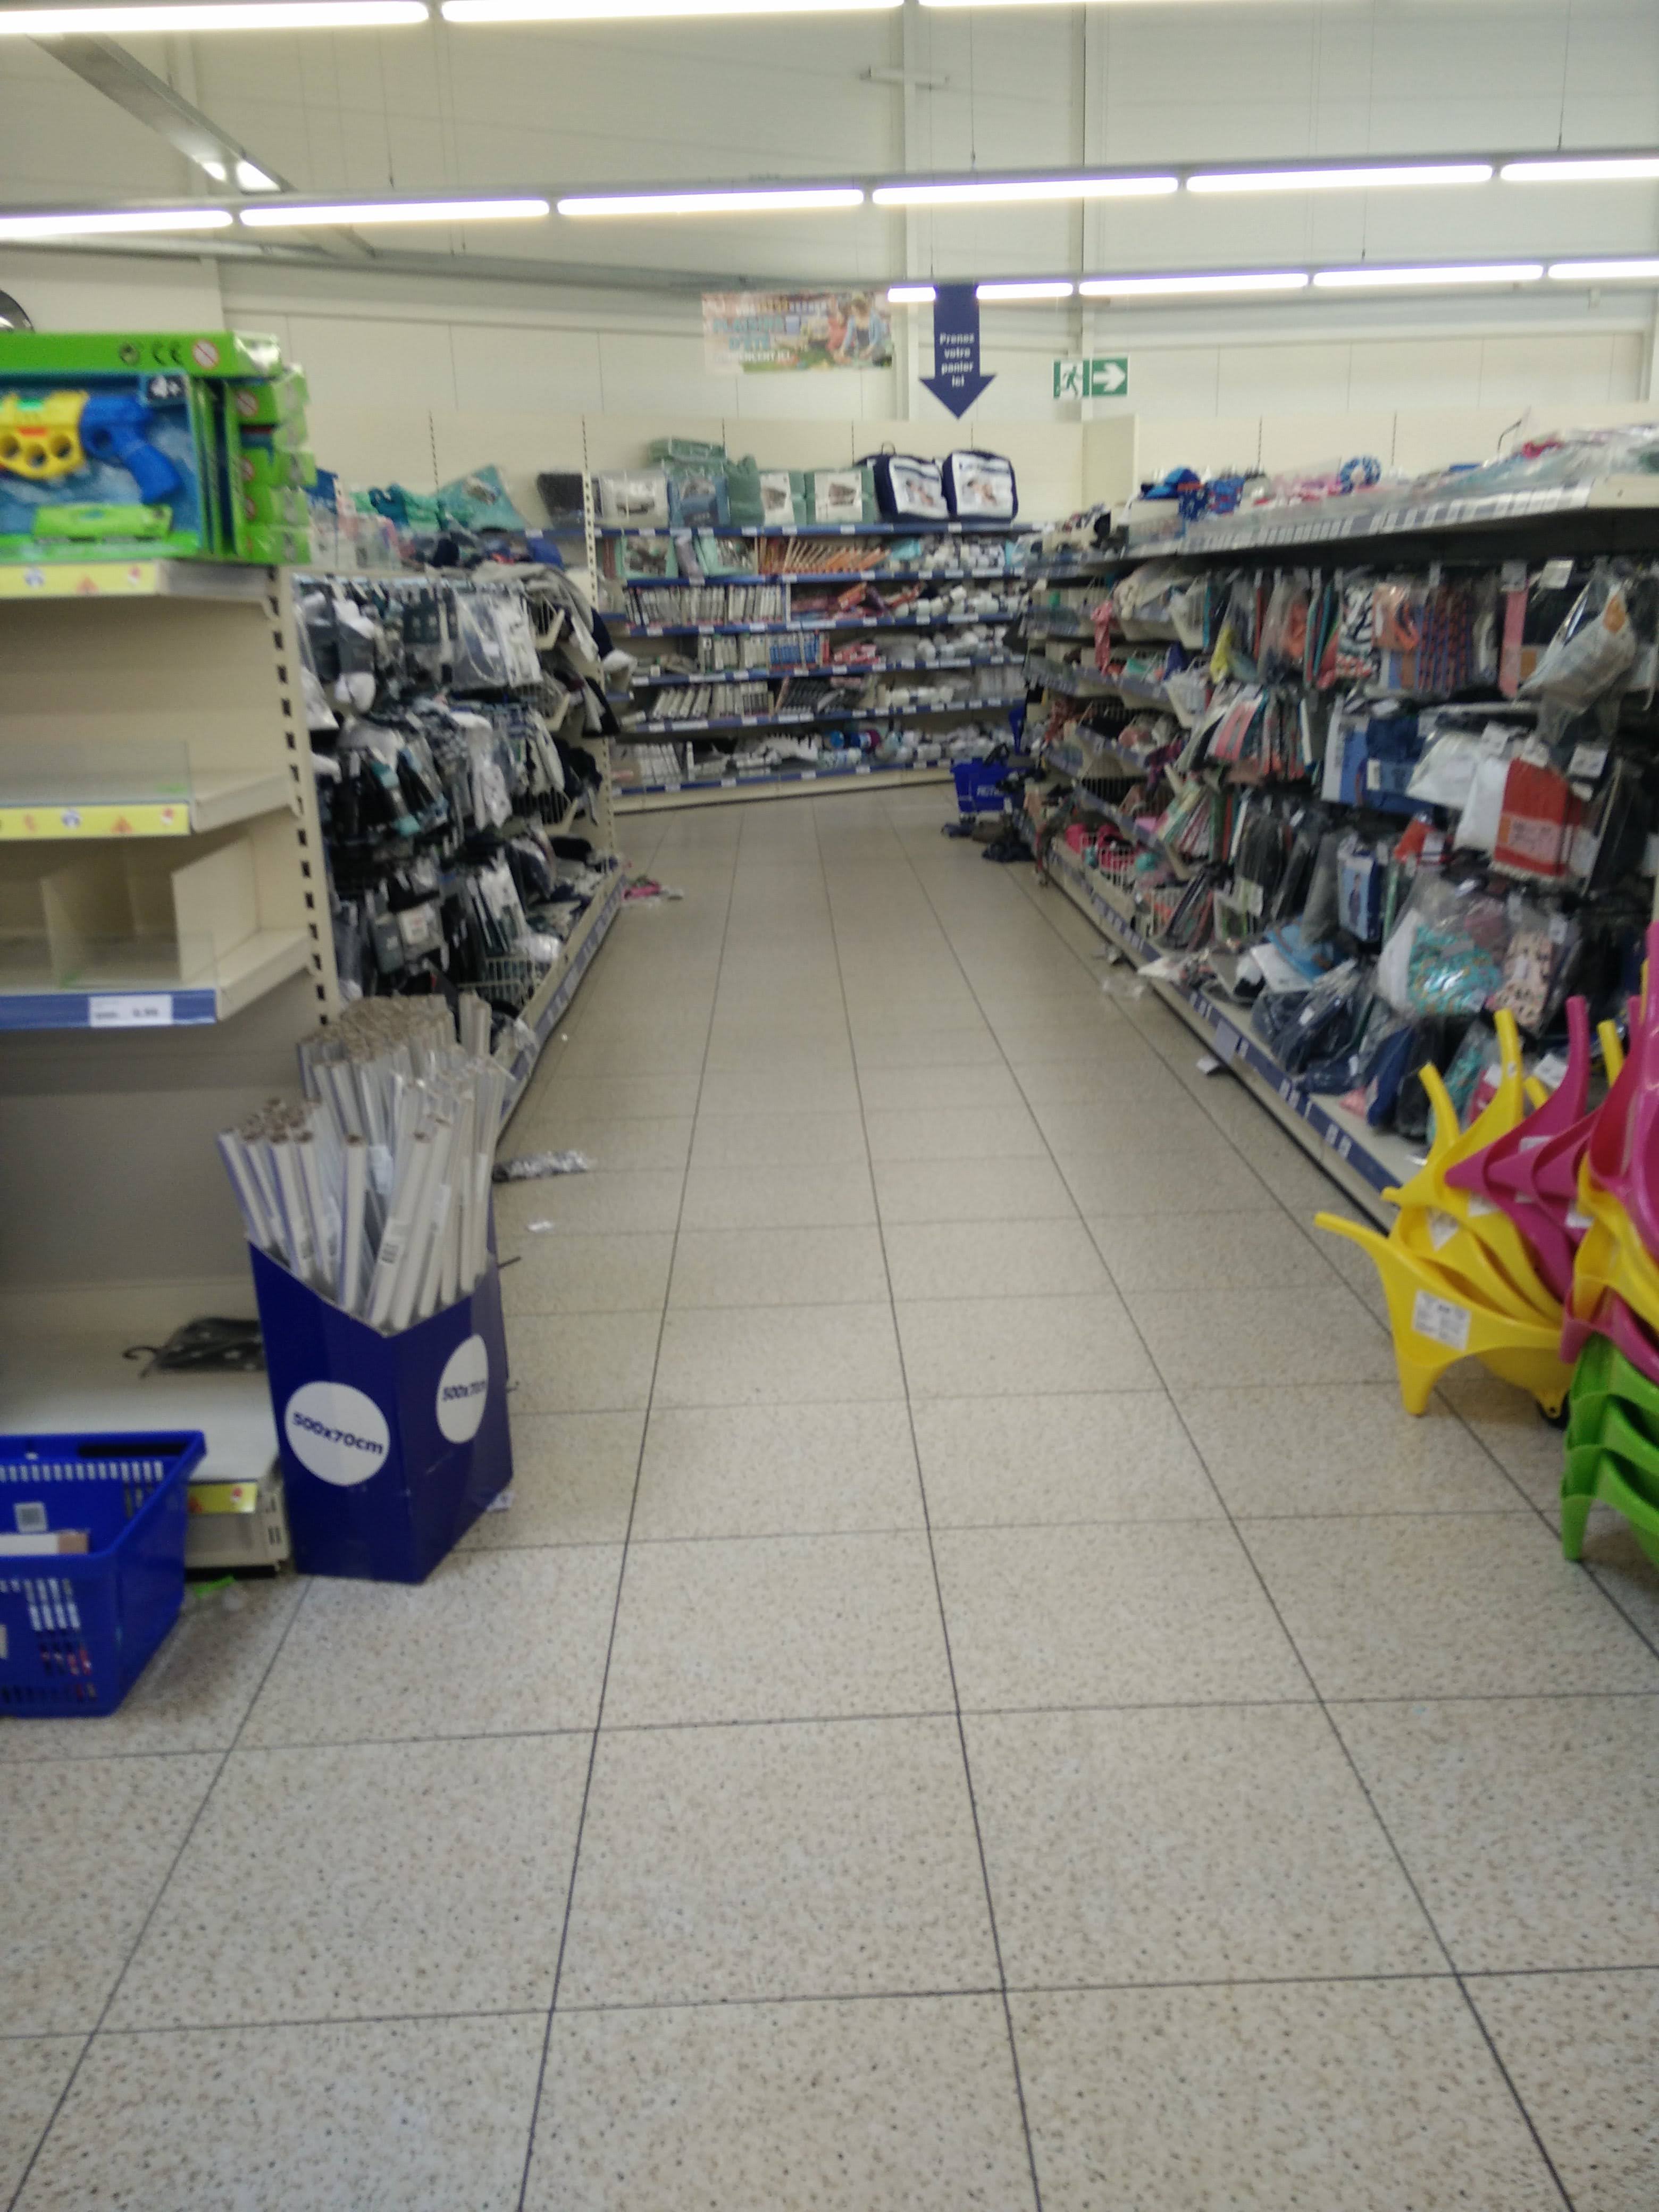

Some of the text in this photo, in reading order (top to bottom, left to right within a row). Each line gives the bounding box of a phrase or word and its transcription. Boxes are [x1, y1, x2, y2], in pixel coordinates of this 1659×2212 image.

[940, 332, 975, 345] Prenez
[944, 347, 970, 359] votre
[941, 361, 974, 375] panier
[294, 1412, 383, 1455] 500x70cm
